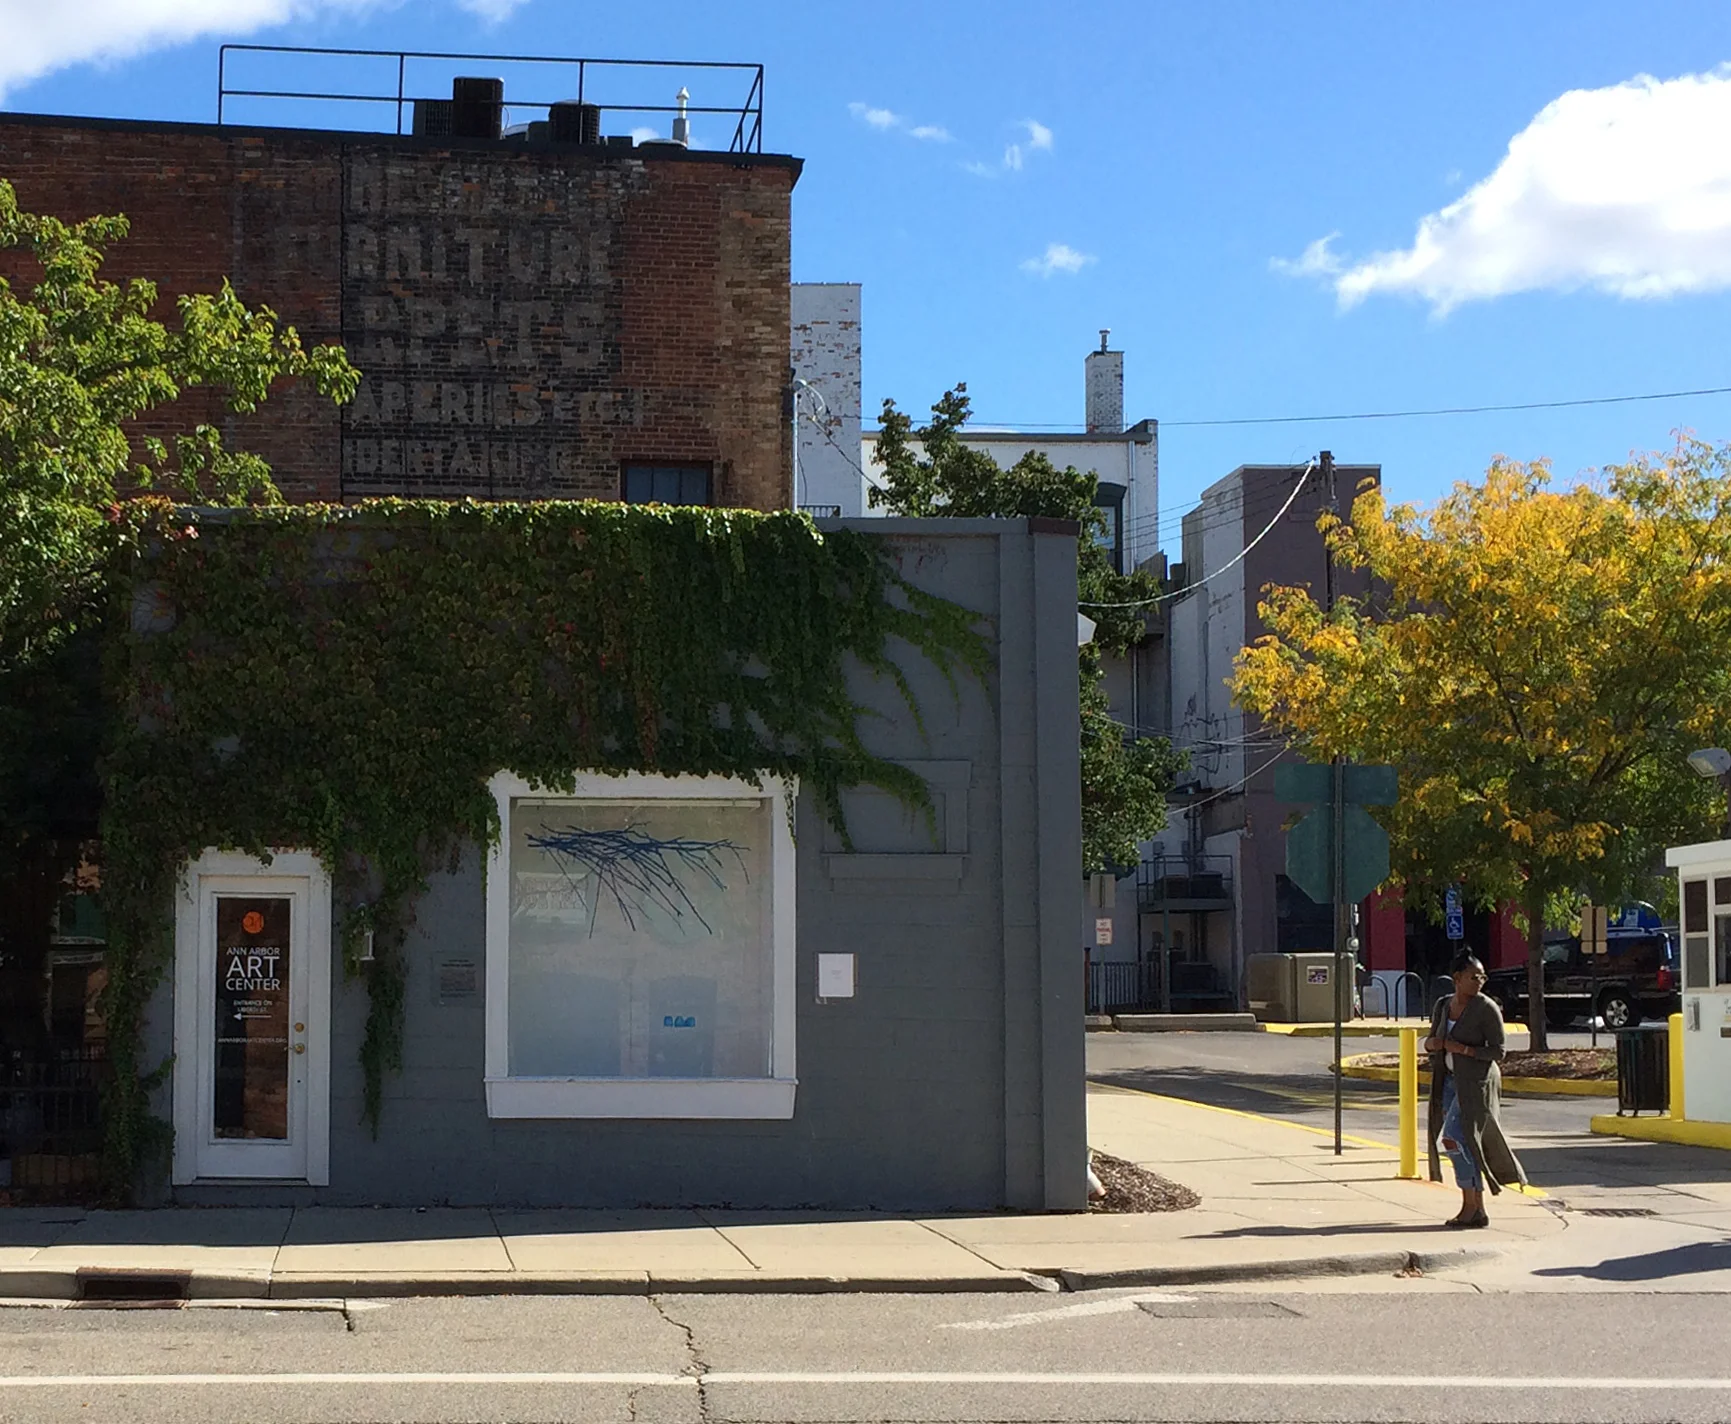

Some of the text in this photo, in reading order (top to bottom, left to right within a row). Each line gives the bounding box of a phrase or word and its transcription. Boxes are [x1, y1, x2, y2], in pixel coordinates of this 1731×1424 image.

[226, 947, 280, 956] ANN ARBOR
[226, 955, 280, 978] ART
[225, 978, 281, 991] CENTER
